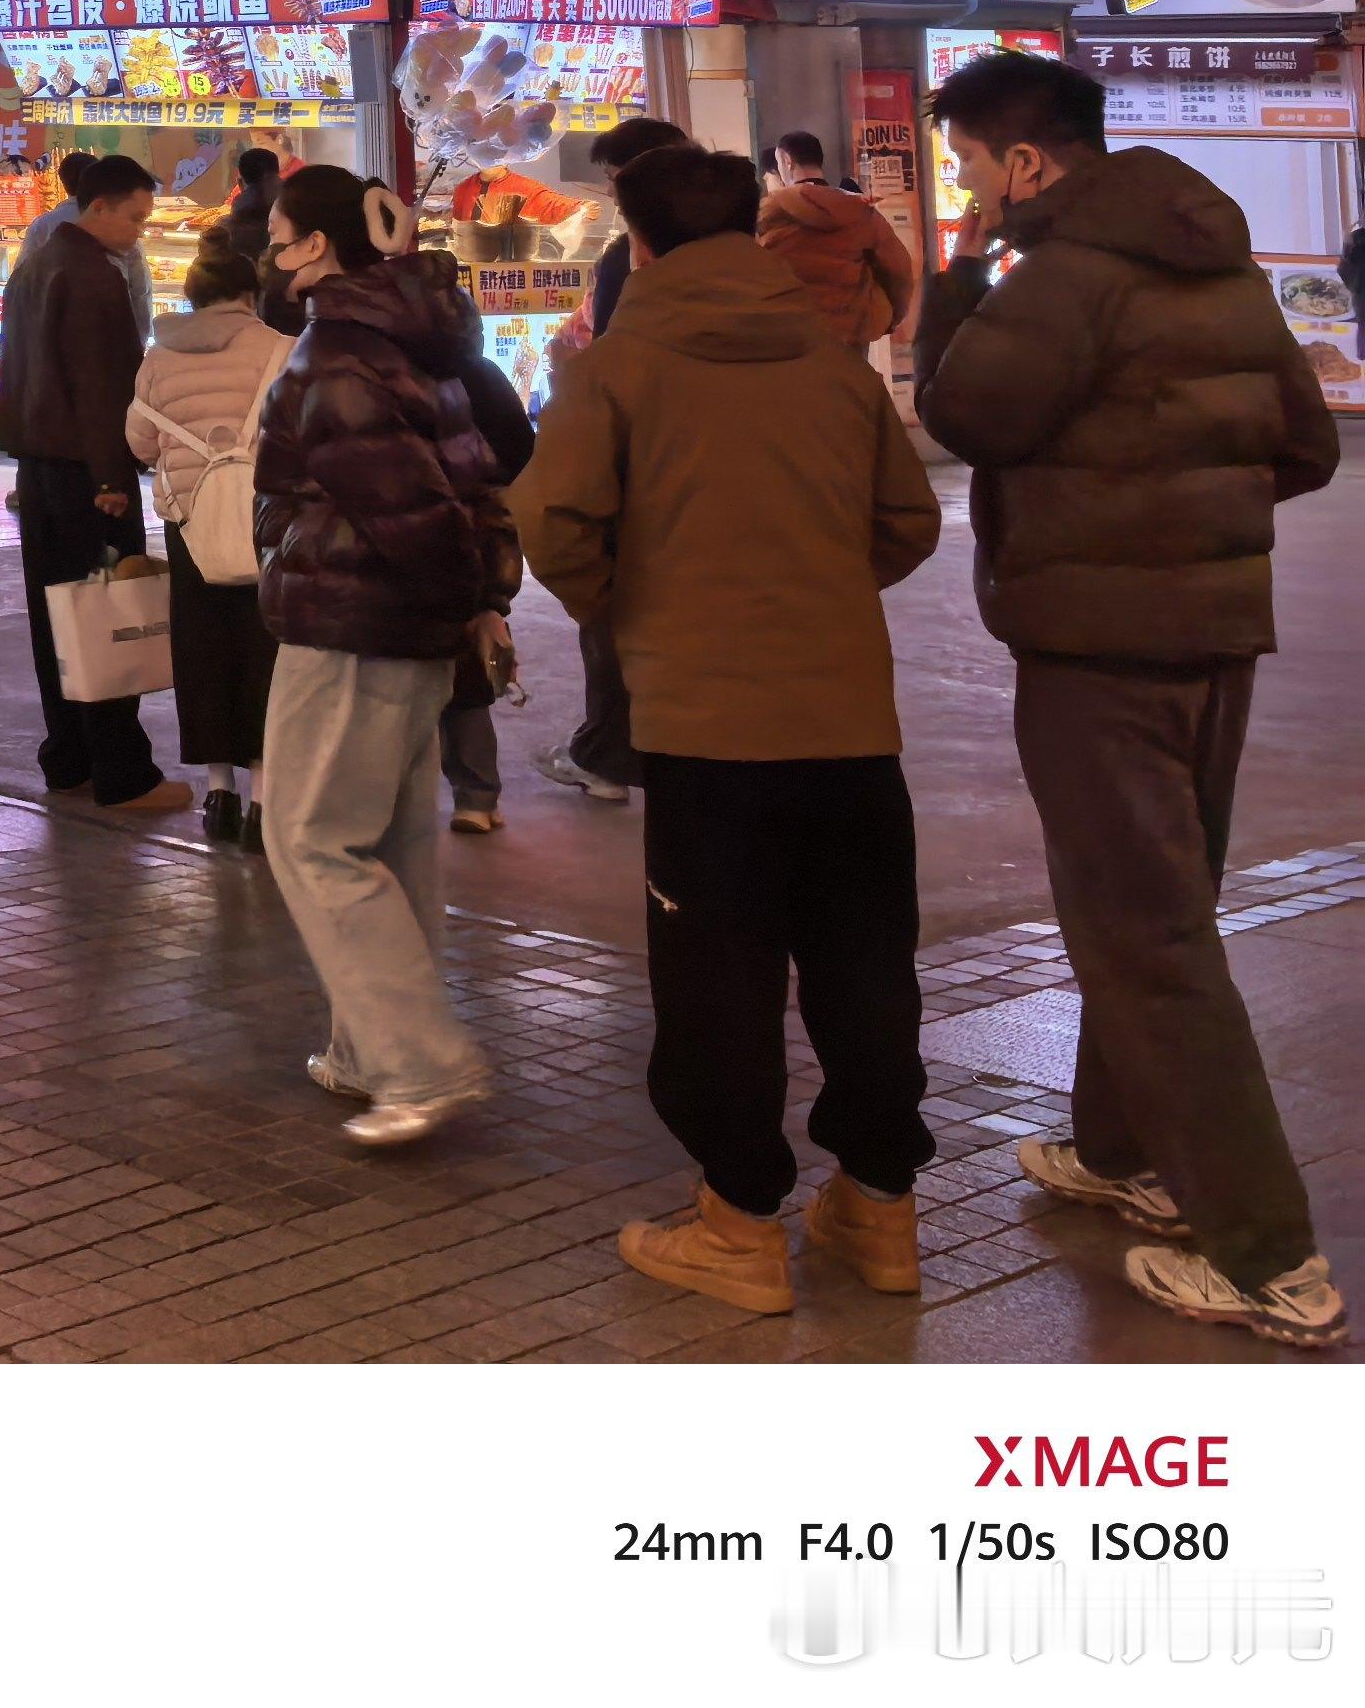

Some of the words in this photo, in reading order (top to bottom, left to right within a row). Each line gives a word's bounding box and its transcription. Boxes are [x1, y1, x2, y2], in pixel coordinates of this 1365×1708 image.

[1091, 45, 1231, 69] 子长煎饼
[893, 124, 910, 142] US
